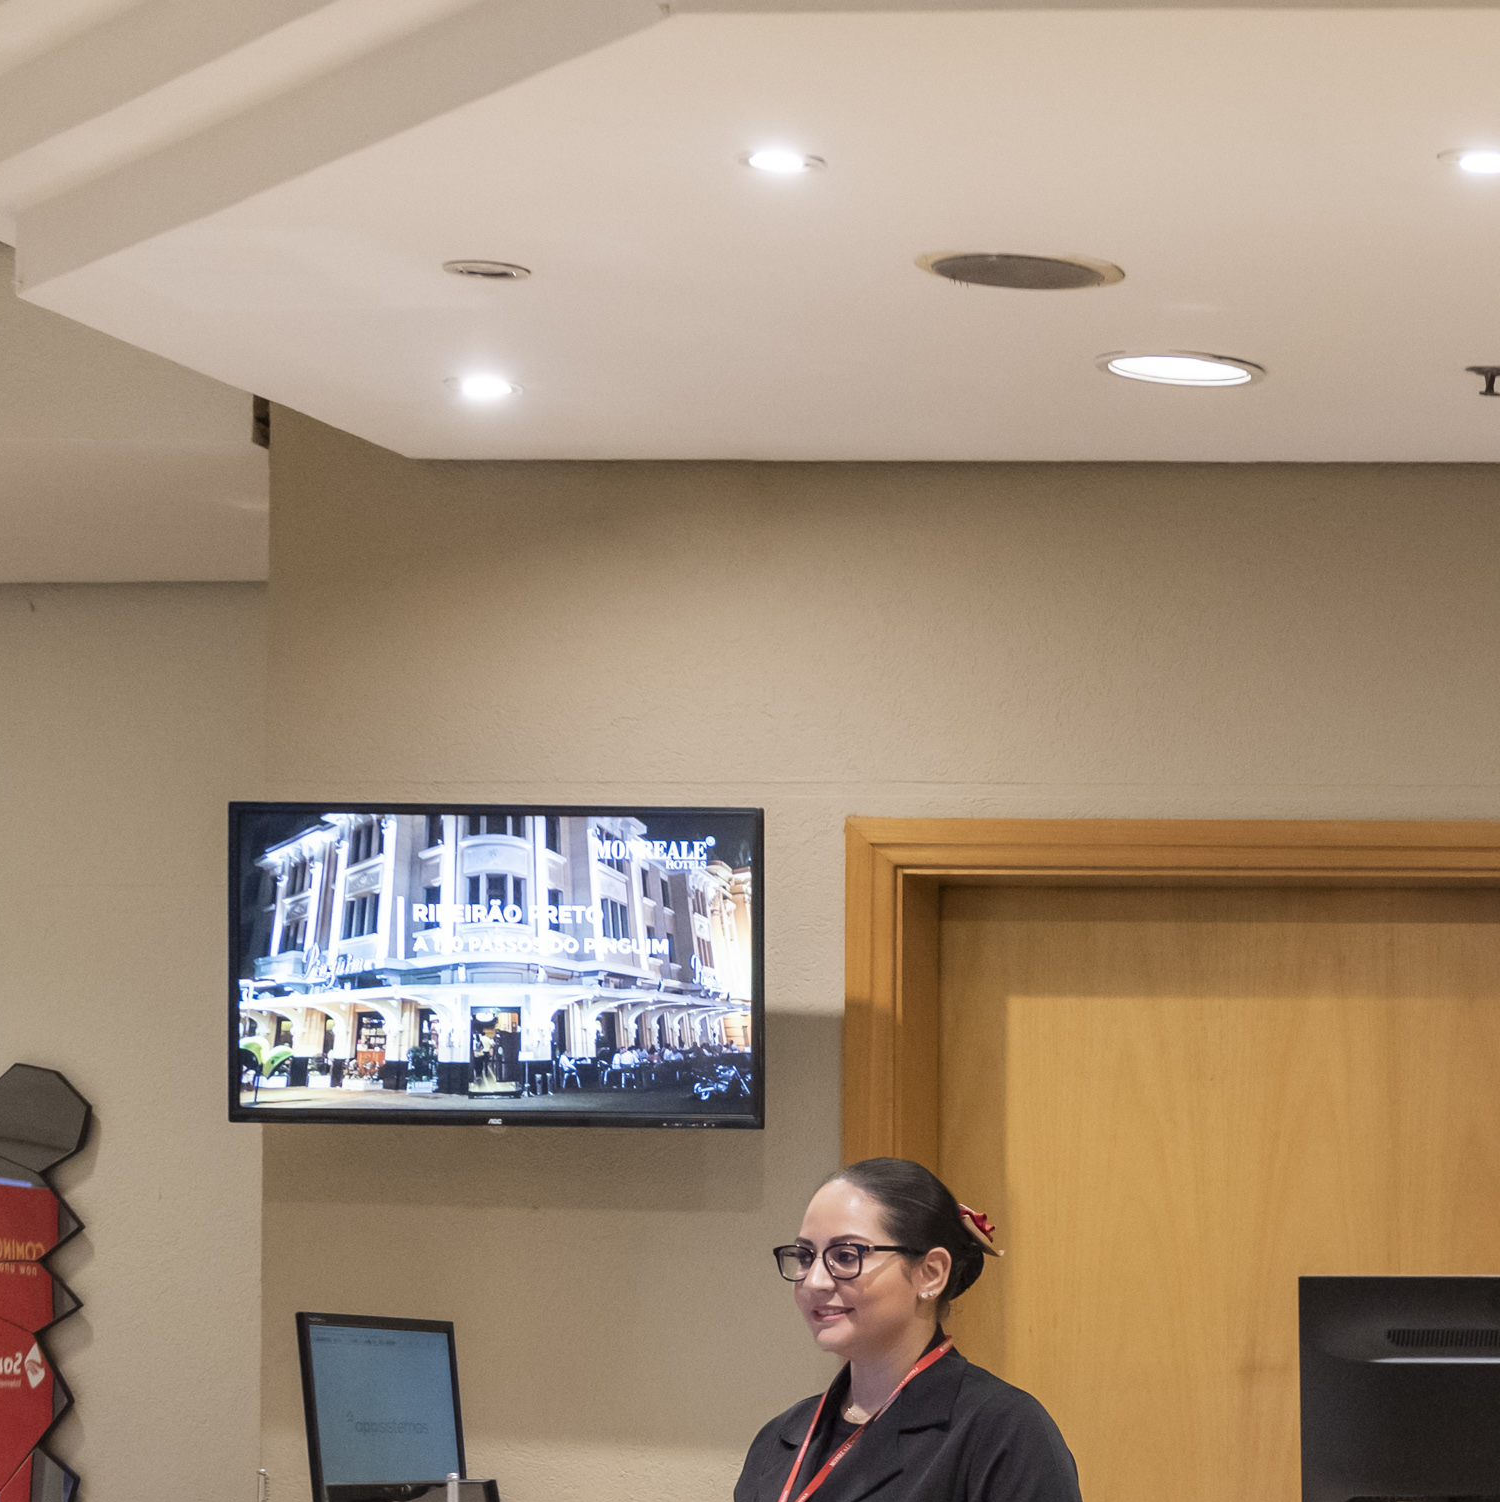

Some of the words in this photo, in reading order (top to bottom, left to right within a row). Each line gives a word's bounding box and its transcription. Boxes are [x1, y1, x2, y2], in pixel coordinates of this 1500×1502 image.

[666, 860, 707, 870] HOTELS
[412, 935, 430, 952] A
[431, 934, 465, 953] 10
[548, 936, 580, 954] DO
[583, 937, 670, 955] PNGUIM
